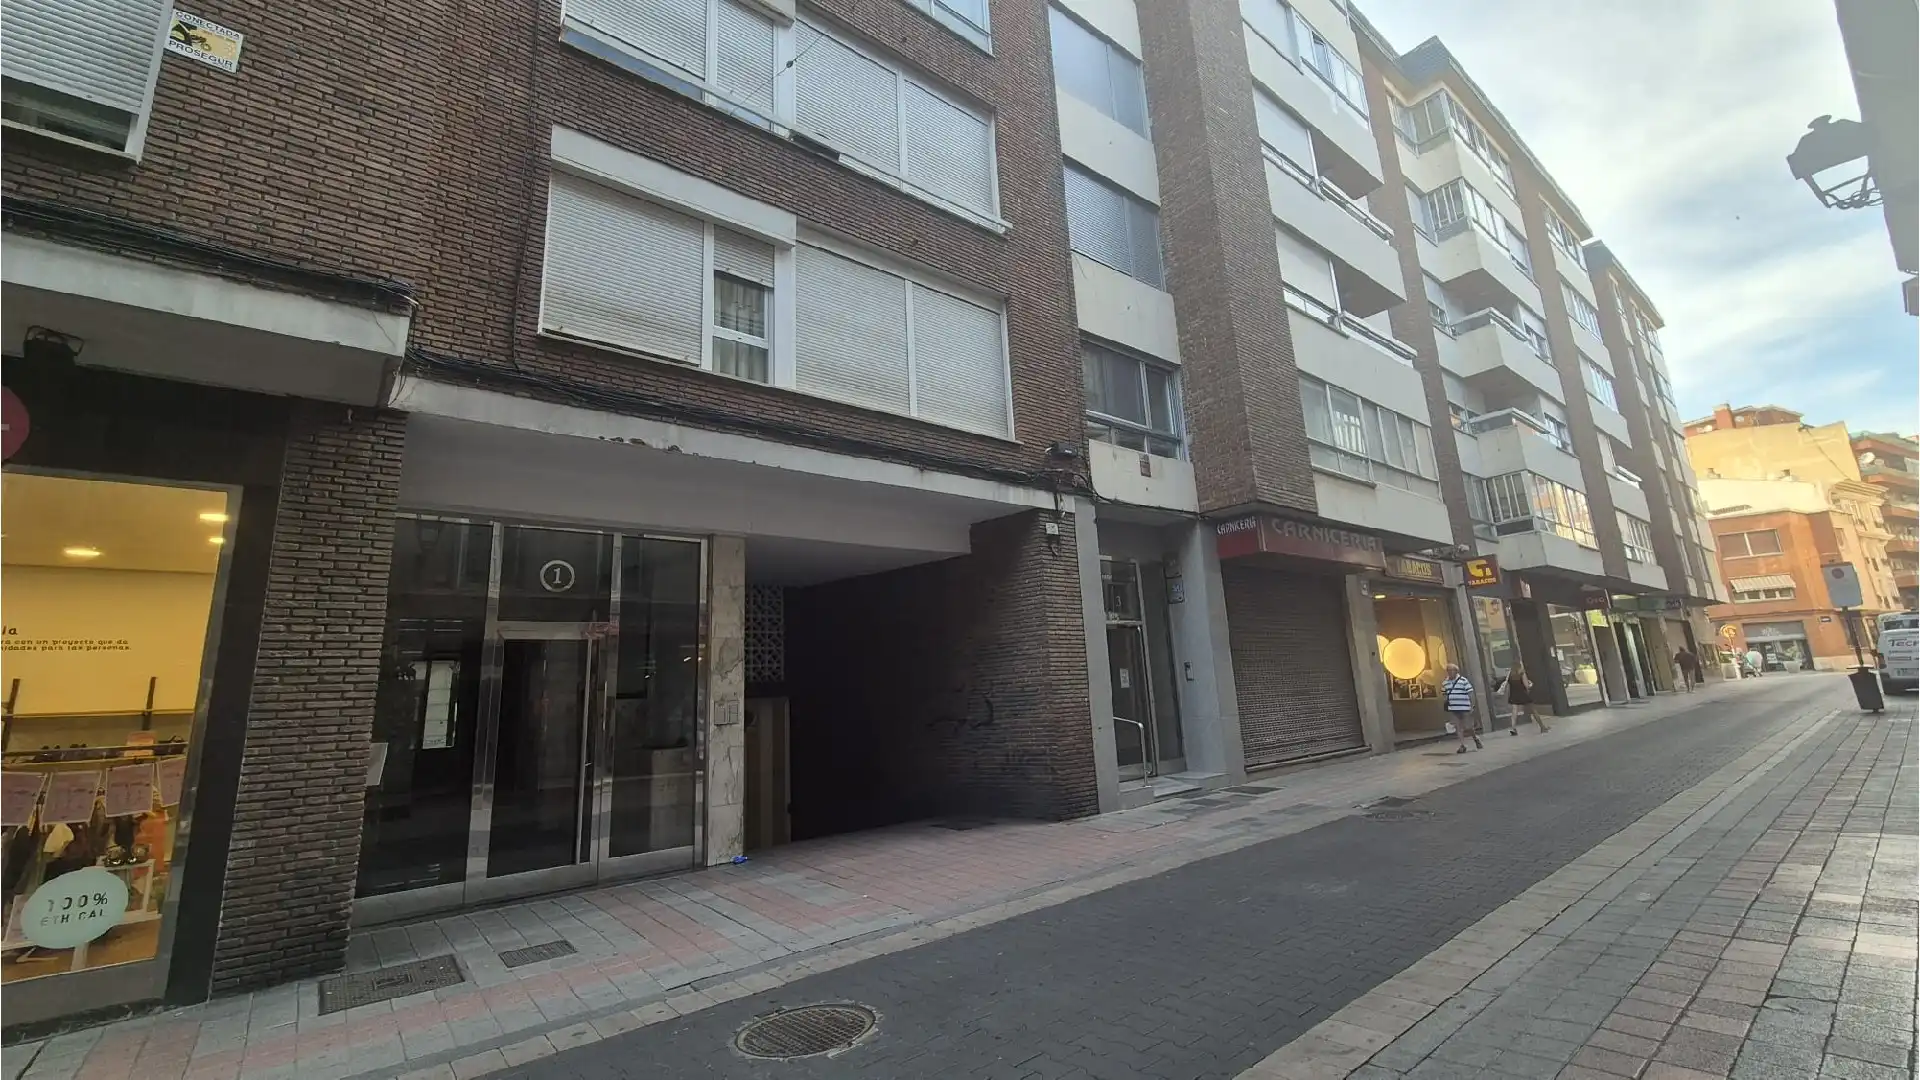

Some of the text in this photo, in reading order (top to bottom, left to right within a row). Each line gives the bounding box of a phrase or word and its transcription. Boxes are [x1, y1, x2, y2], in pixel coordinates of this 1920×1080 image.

[175, 11, 240, 40] CONECTADA
[168, 40, 233, 68] PROSEGUR
[552, 567, 562, 584] 1
[40, 909, 104, 927] ETHCAL
